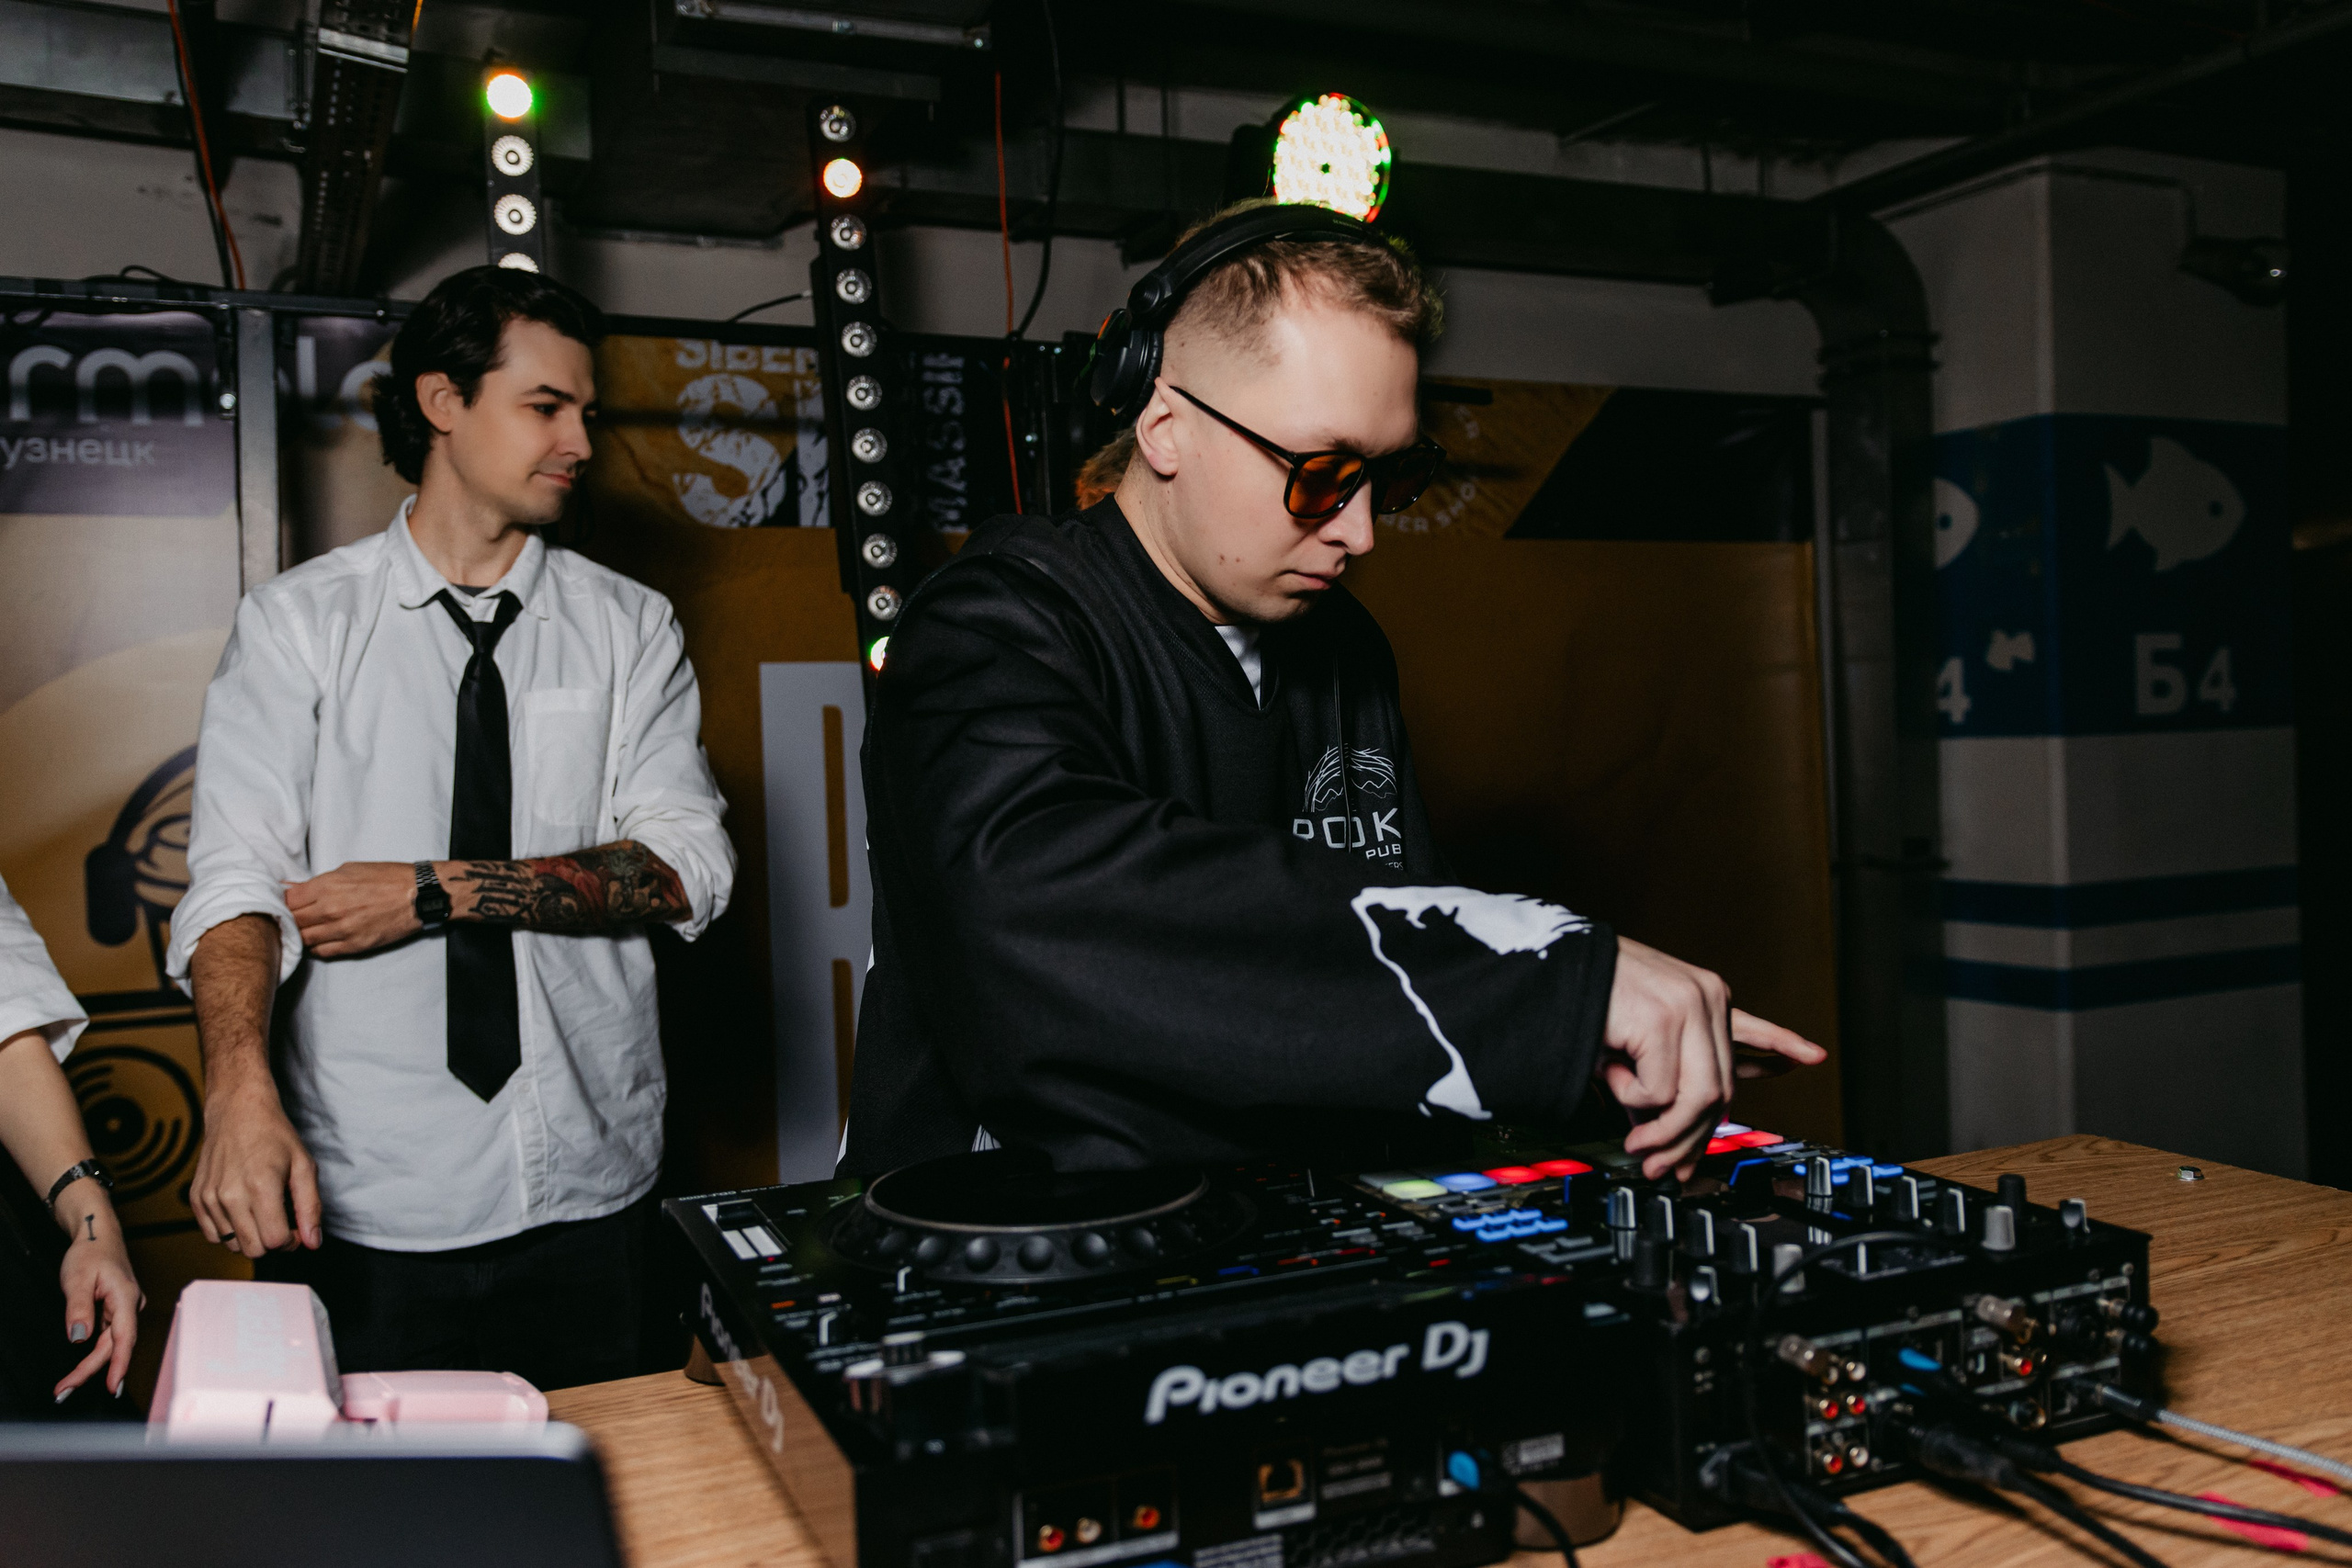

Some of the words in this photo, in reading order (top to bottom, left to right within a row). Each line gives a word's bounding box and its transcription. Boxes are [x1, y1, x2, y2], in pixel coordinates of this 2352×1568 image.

[0, 435, 155, 470] узнецк
[2133, 631, 2239, 717] Б4
[1365, 843, 1402, 860] PUB
[1143, 1342, 1411, 1426] Pioneer
